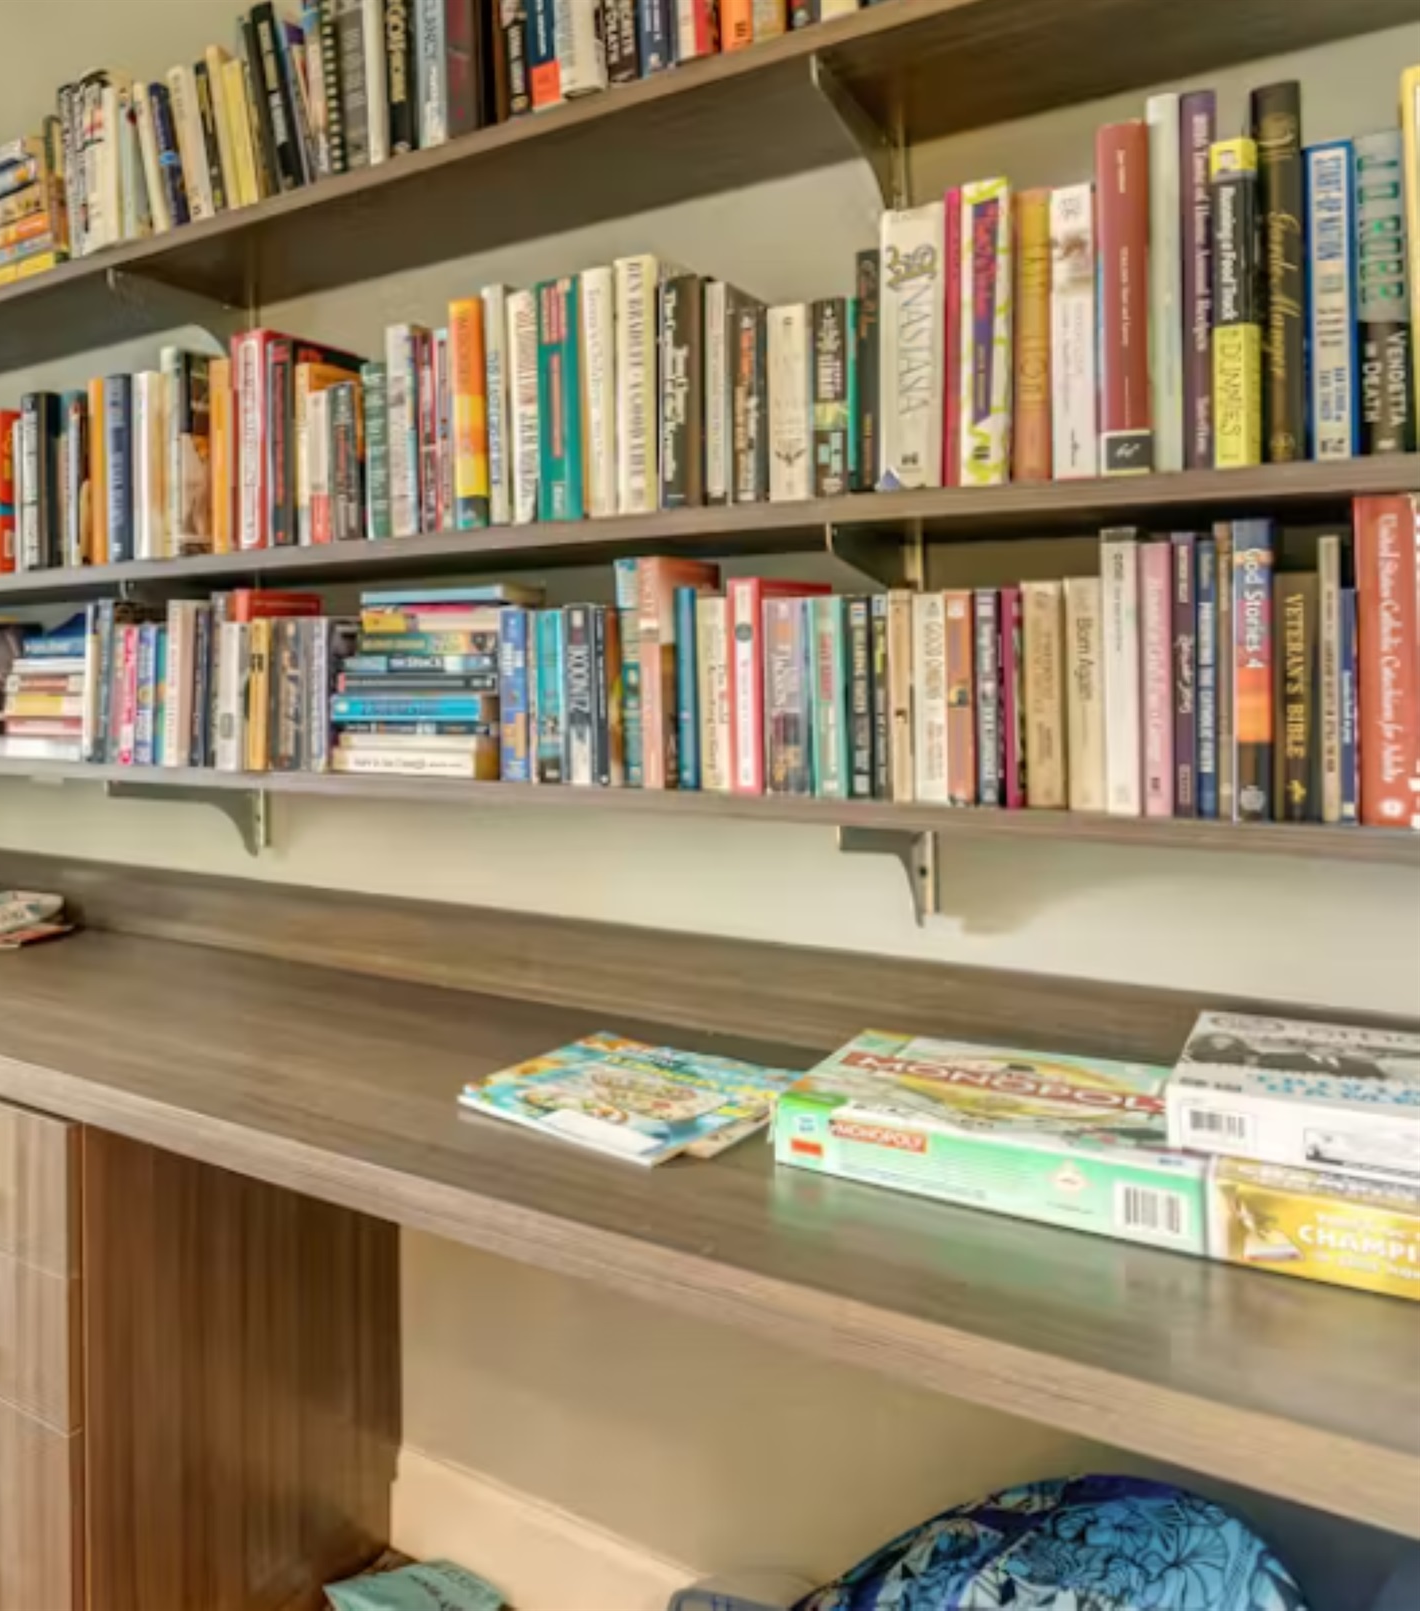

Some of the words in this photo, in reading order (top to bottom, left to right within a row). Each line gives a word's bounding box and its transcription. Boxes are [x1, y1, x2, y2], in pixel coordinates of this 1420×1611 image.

[1194, 151, 1208, 183] Taste
[1195, 206, 1208, 245] Home
[1217, 186, 1236, 240] Running
[1220, 251, 1237, 284] Food
[1267, 211, 1300, 277] Garde
[1359, 214, 1404, 304] ROBB
[1192, 300, 1208, 351] Recipes
[1220, 286, 1237, 321] Truck
[1262, 280, 1300, 379] Manger
[886, 244, 938, 417] ANASTASIA
[1218, 342, 1241, 438] DUMMIES
[1363, 361, 1382, 423] DEATH
[1386, 331, 1406, 428] VENDETTA
[1377, 513, 1401, 557] United
[1243, 548, 1267, 584] God
[1076, 616, 1094, 654] Born
[1243, 590, 1267, 652] Stories
[1284, 593, 1306, 694] VETERAN'S
[1380, 602, 1404, 651] Catholic
[567, 644, 589, 713] KOONTZ
[1074, 657, 1094, 702] Again
[1244, 657, 1265, 669] 4
[1285, 703, 1306, 759] BIBLE
[857, 1054, 1168, 1116] MONOPOL
[833, 1120, 926, 1153] MONOPOLY
[1297, 1223, 1418, 1265] CHAMPI
